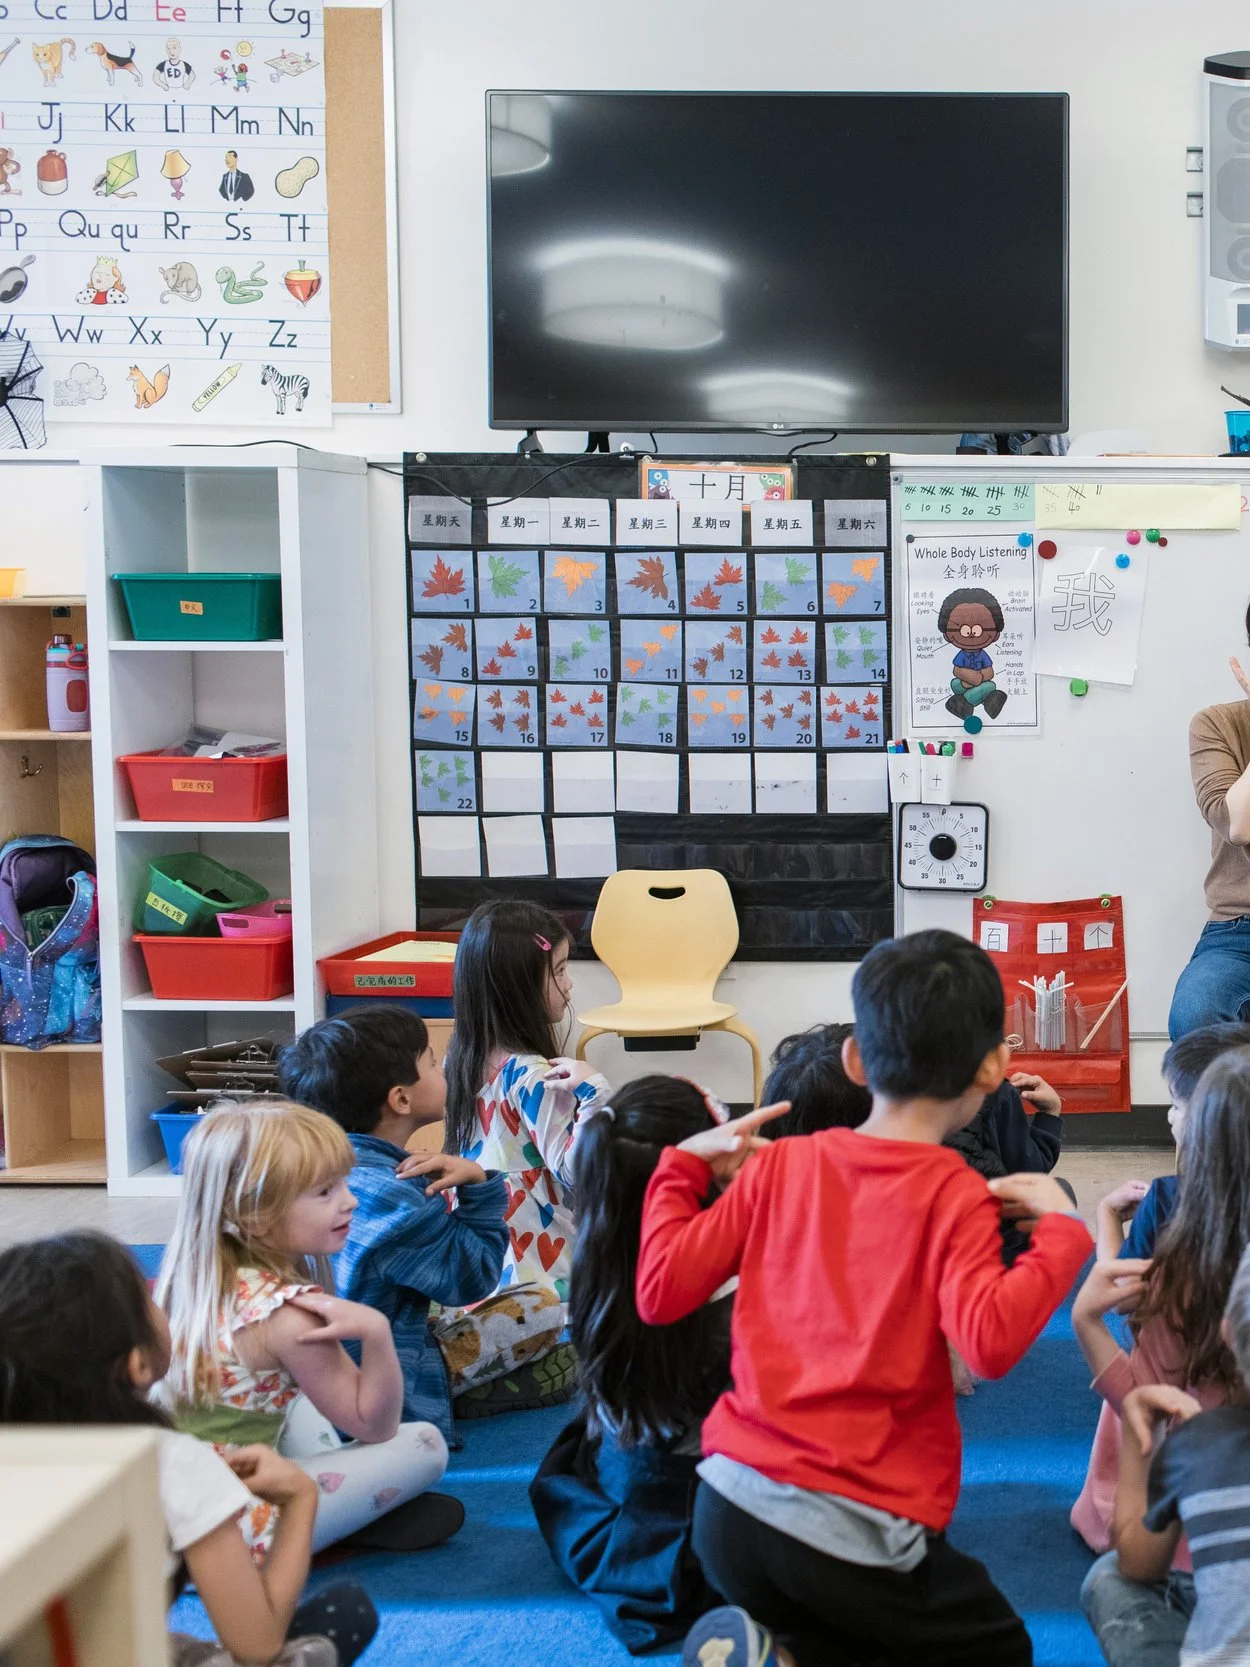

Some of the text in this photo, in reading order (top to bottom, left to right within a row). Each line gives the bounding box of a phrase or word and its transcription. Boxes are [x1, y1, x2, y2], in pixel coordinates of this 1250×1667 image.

[35, 0, 310, 38] Cc Dd Ee Ff Gg
[167, 67, 181, 79] ED
[37, 102, 63, 144] Jj
[105, 103, 135, 133] Kk
[211, 106, 259, 135] Mm
[279, 107, 313, 136] Nn
[59, 210, 100, 239] Qu
[164, 212, 190, 241] Rr
[225, 213, 252, 241] Ss
[280, 214, 310, 241] Tt
[52, 315, 298, 359] Ww Xx Yy Zz
[203, 380, 221, 400] YELLOW
[689, 472, 746, 501] 十月
[921, 503, 930, 512] 10
[941, 504, 951, 514] 15
[962, 507, 974, 516] 20
[987, 505, 1002, 515] 25
[421, 512, 877, 531] 星期天 星期一 星期二 星期三 星期四 星期五 星期六
[915, 546, 1027, 560] Whole Body Listening
[943, 563, 1000, 579] 全身聆听
[464, 598, 881, 612] 1 2 3 4 5 6 7
[1052, 572, 1115, 636] 我
[462, 666, 886, 680] 8 9 10 11 12 13 14
[455, 730, 878, 744] 15 16 17 18 19 20 21
[458, 799, 472, 809] 22
[987, 928, 1001, 950] 百
